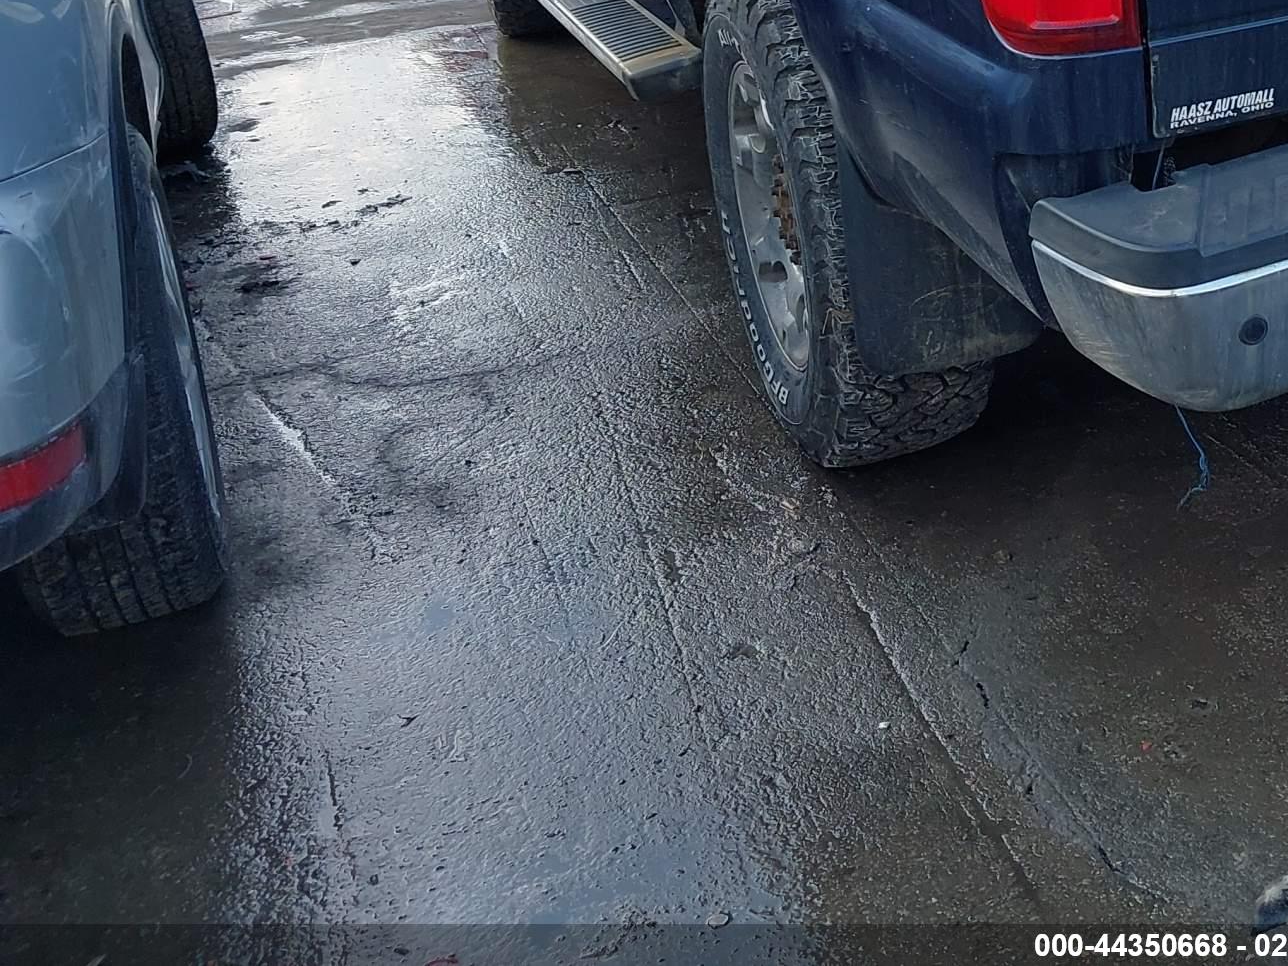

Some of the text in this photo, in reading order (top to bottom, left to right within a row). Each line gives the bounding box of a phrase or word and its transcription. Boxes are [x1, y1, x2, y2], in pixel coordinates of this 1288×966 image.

[1170, 88, 1275, 123] HAASZ AUTOMALL
[1170, 101, 1274, 130] RAVENNA, OHIO
